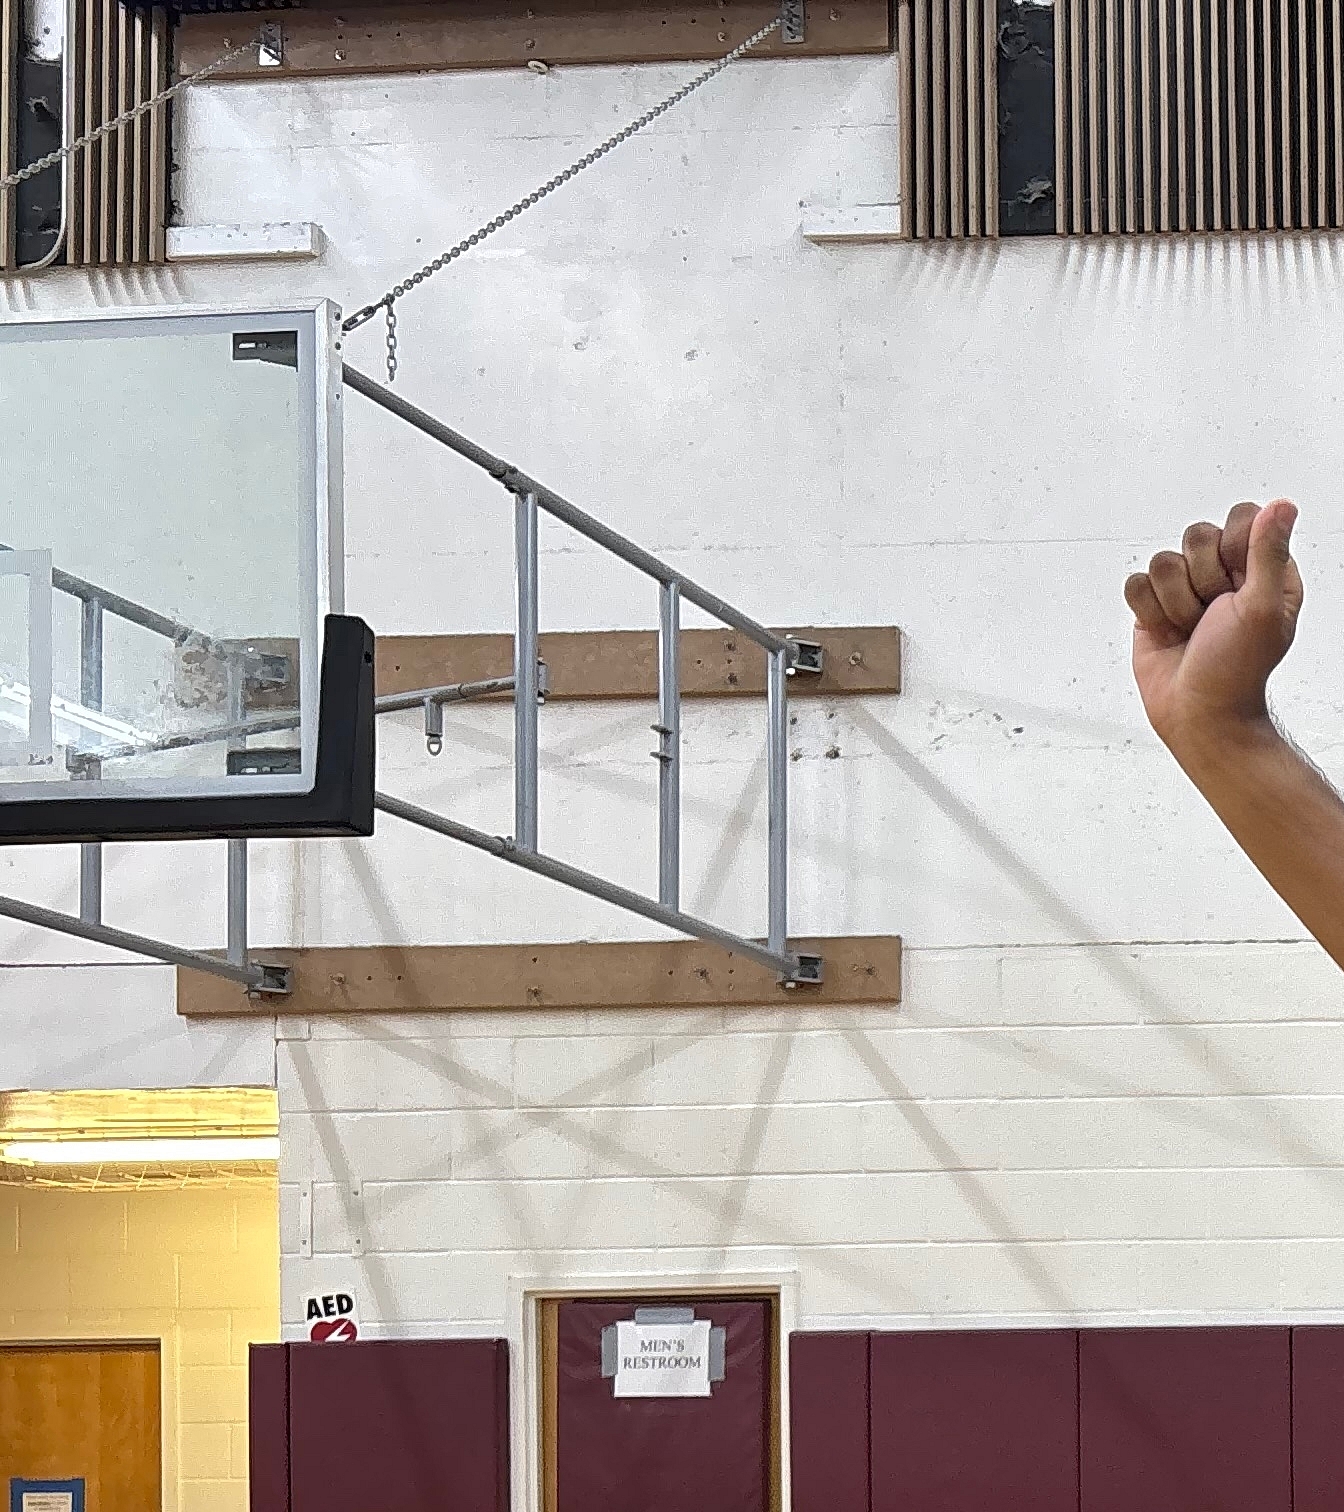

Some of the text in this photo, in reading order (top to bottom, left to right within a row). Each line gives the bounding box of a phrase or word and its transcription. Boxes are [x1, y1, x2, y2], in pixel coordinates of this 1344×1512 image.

[307, 1294, 353, 1321] AED
[640, 1339, 685, 1352] MEN'S
[623, 1356, 701, 1369] RESTROOM
